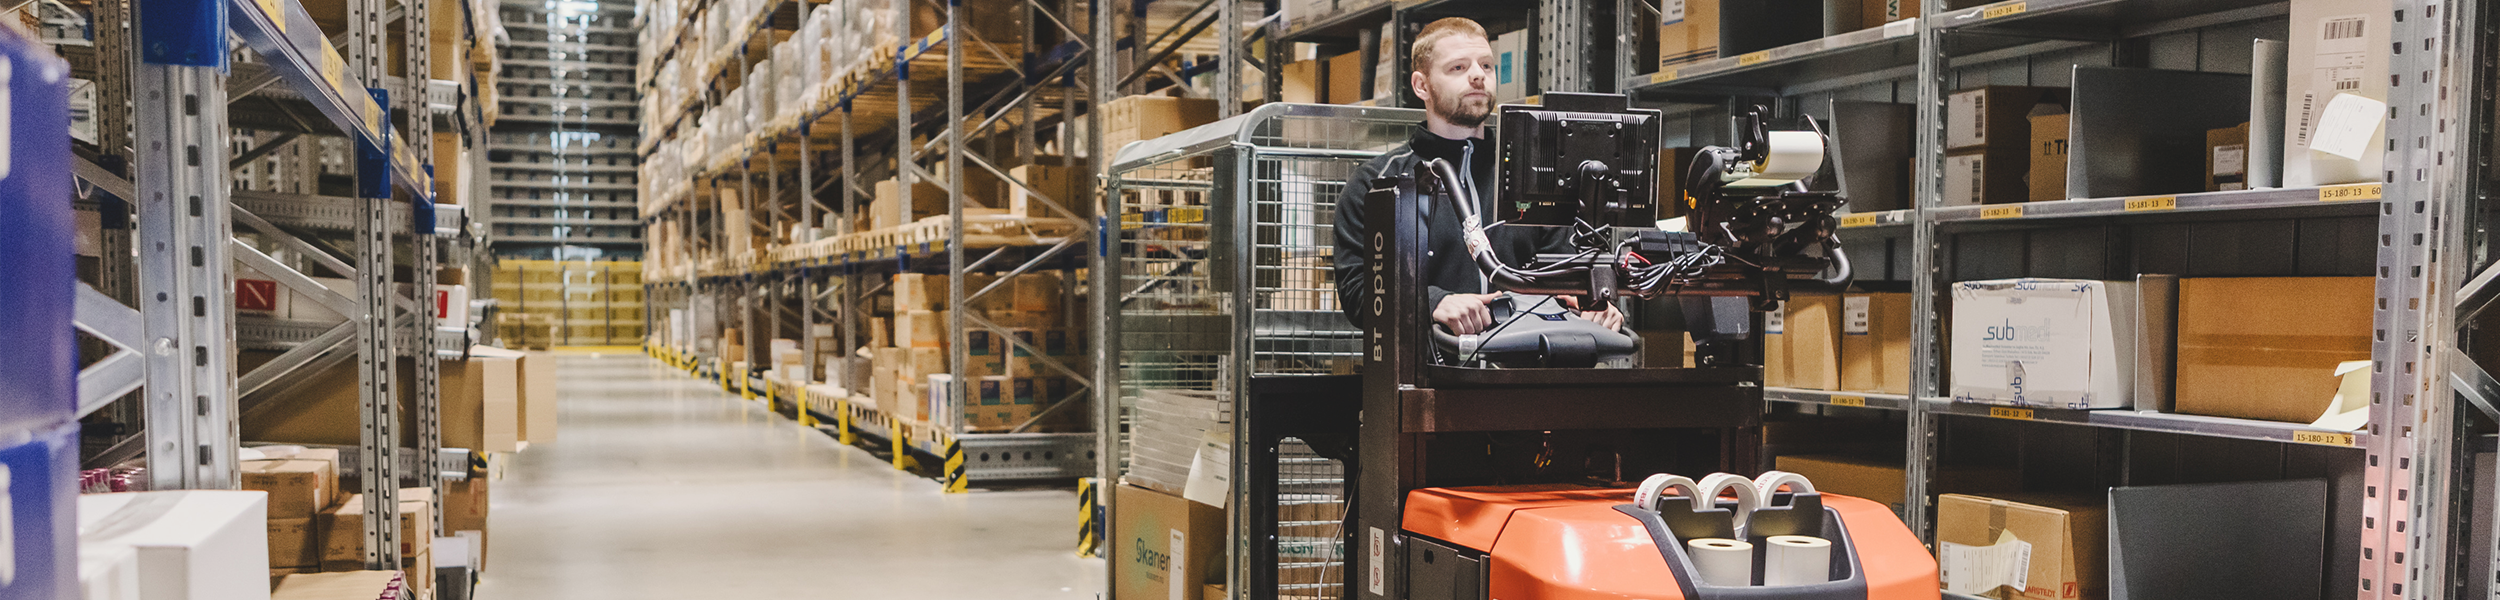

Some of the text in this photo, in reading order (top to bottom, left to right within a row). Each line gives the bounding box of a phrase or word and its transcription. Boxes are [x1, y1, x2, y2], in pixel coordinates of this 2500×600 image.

[2371, 186, 2382, 195] 60
[2166, 198, 2175, 207] 20
[243, 281, 271, 308] N
[1372, 231, 1386, 362] BT optio
[2344, 436, 2353, 445] 36
[2025, 585, 2056, 598] ARSTEDT
